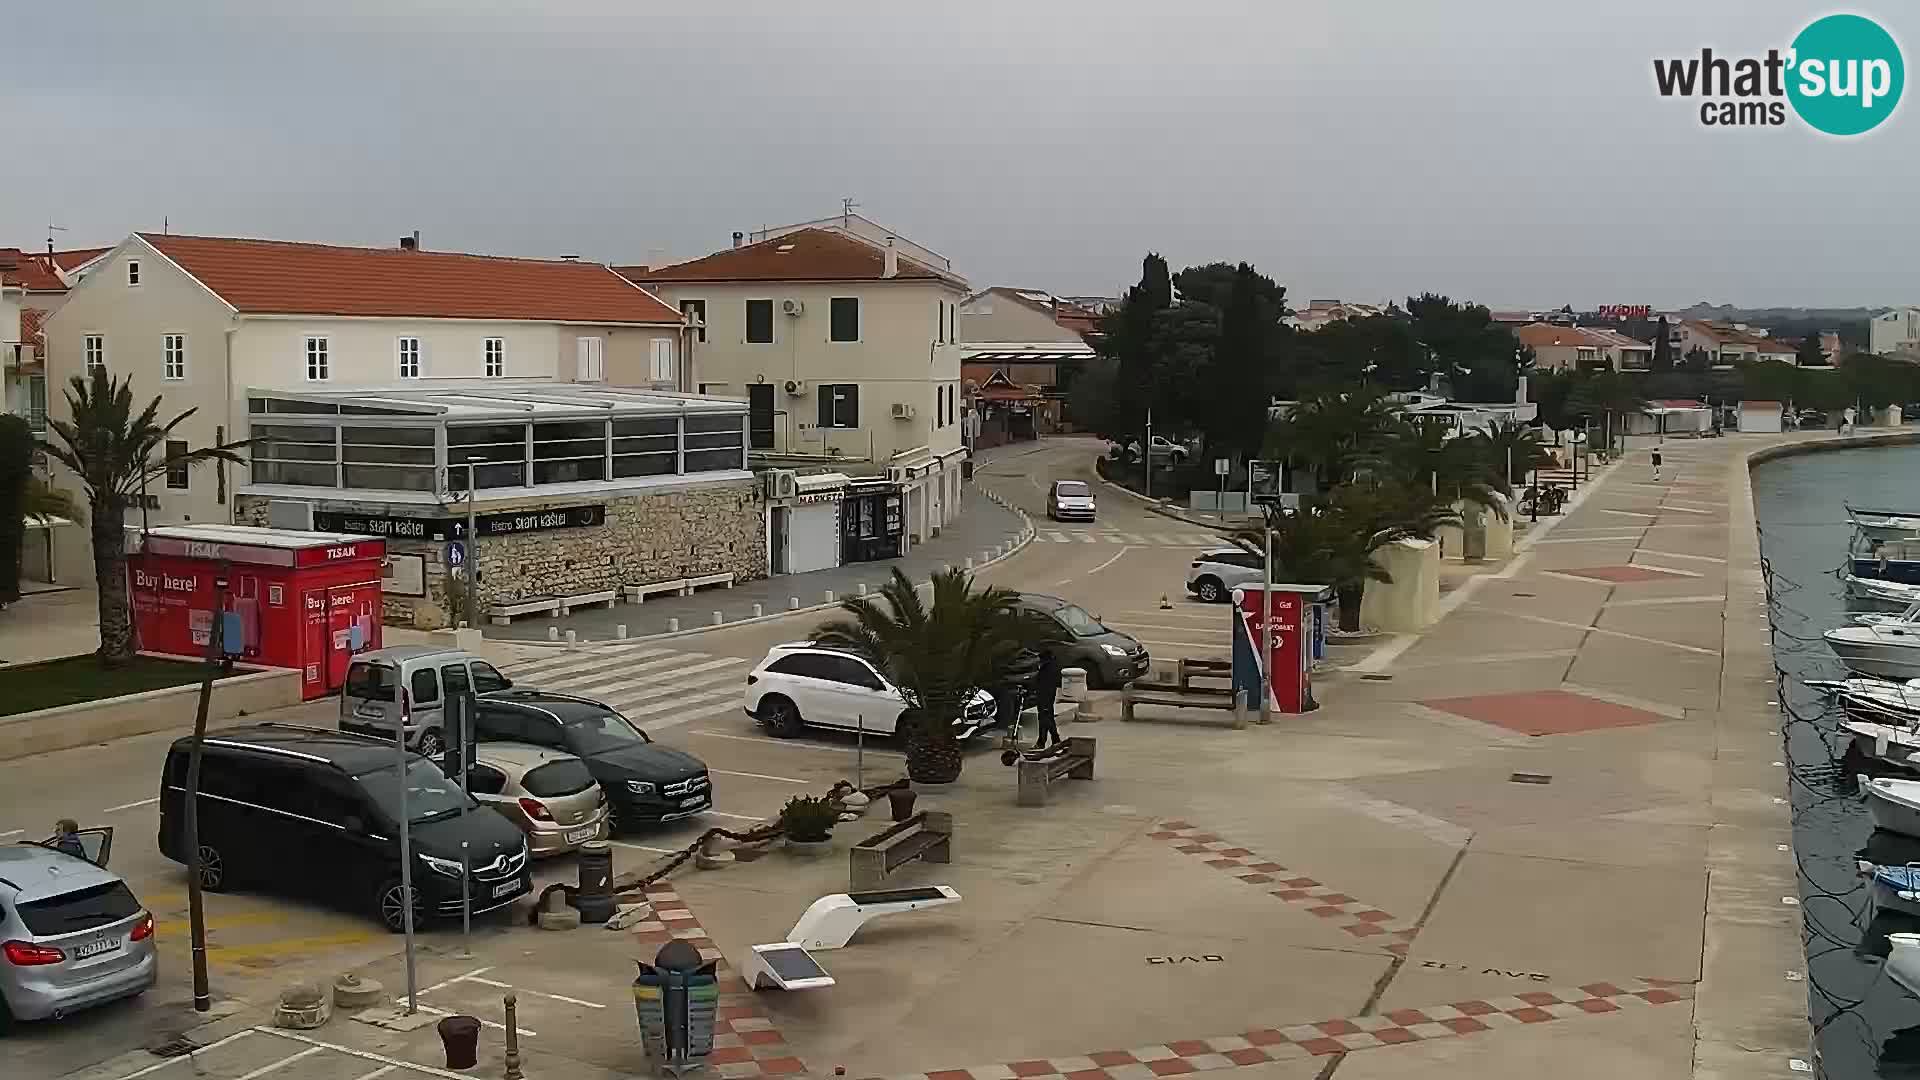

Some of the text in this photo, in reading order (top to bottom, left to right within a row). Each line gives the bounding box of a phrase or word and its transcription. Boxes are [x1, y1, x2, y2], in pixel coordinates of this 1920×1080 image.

[326, 546, 356, 559] TISAK
[136, 569, 197, 592] Buy here!
